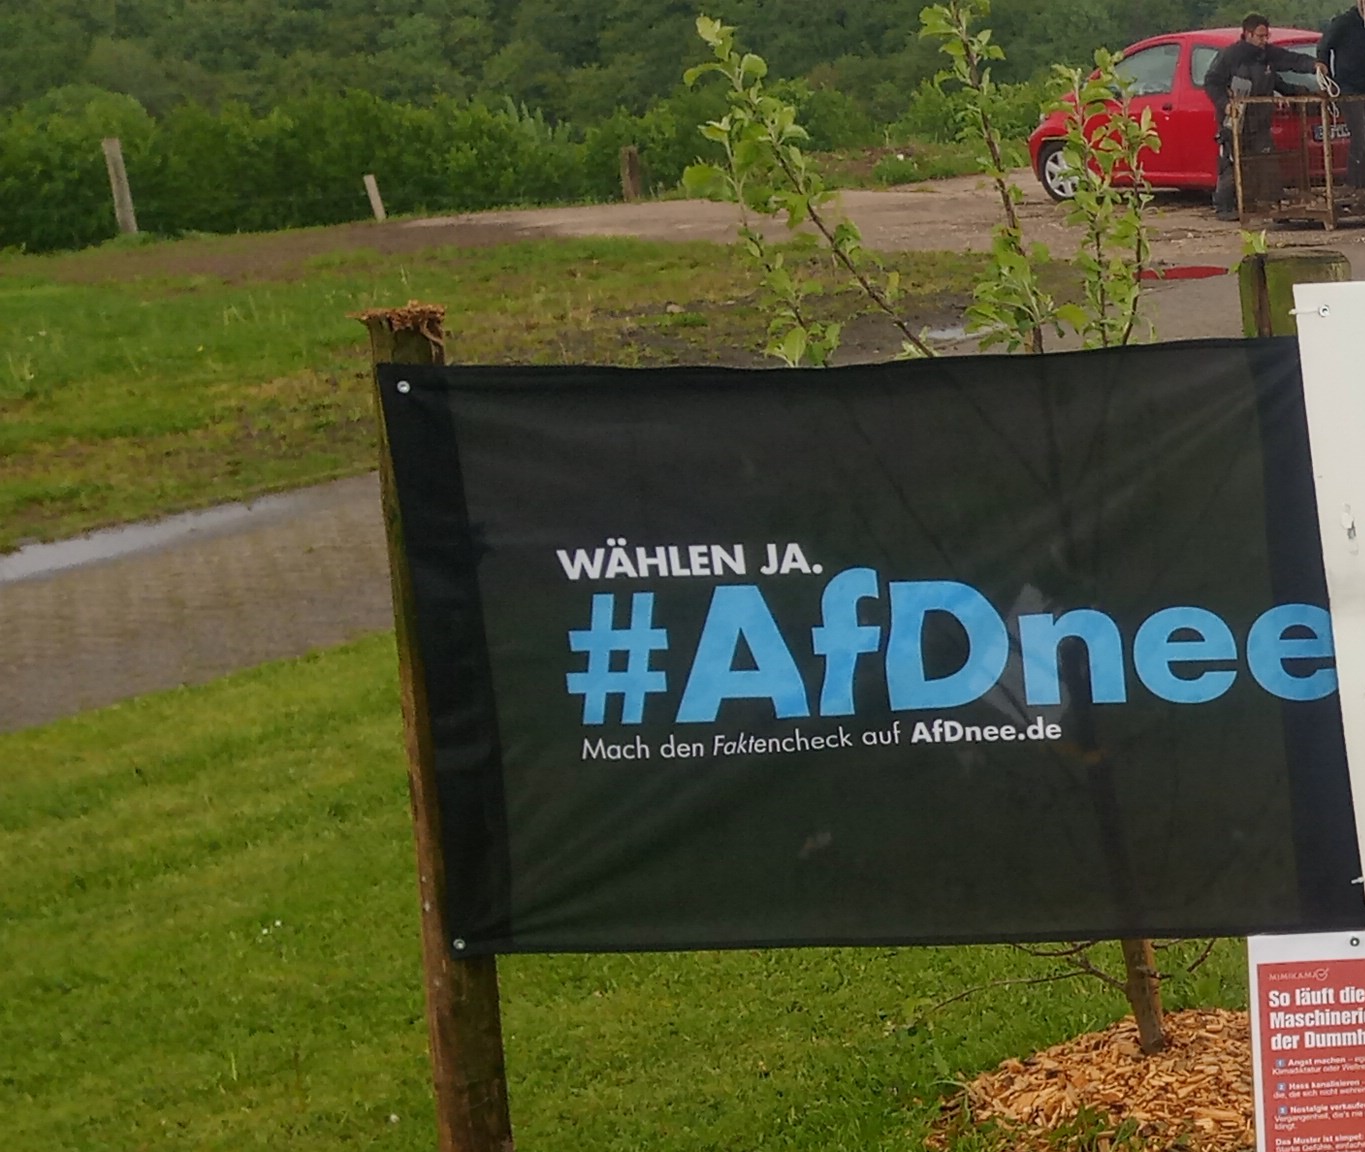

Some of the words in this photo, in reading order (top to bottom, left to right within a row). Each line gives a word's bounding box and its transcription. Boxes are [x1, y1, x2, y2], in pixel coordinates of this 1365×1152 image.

[556, 538, 747, 580] WÄHLEN
[759, 543, 823, 575] JA.
[566, 567, 1338, 724] #AfDnee
[582, 735, 650, 760] Mach
[659, 734, 704, 759] den
[712, 726, 853, 756] Faktencheck
[862, 721, 901, 748] auf
[911, 717, 1062, 744] AfDnee.de
[1269, 990, 1290, 1008] So
[1295, 988, 1335, 1006] läuft
[1271, 1033, 1300, 1051] der
